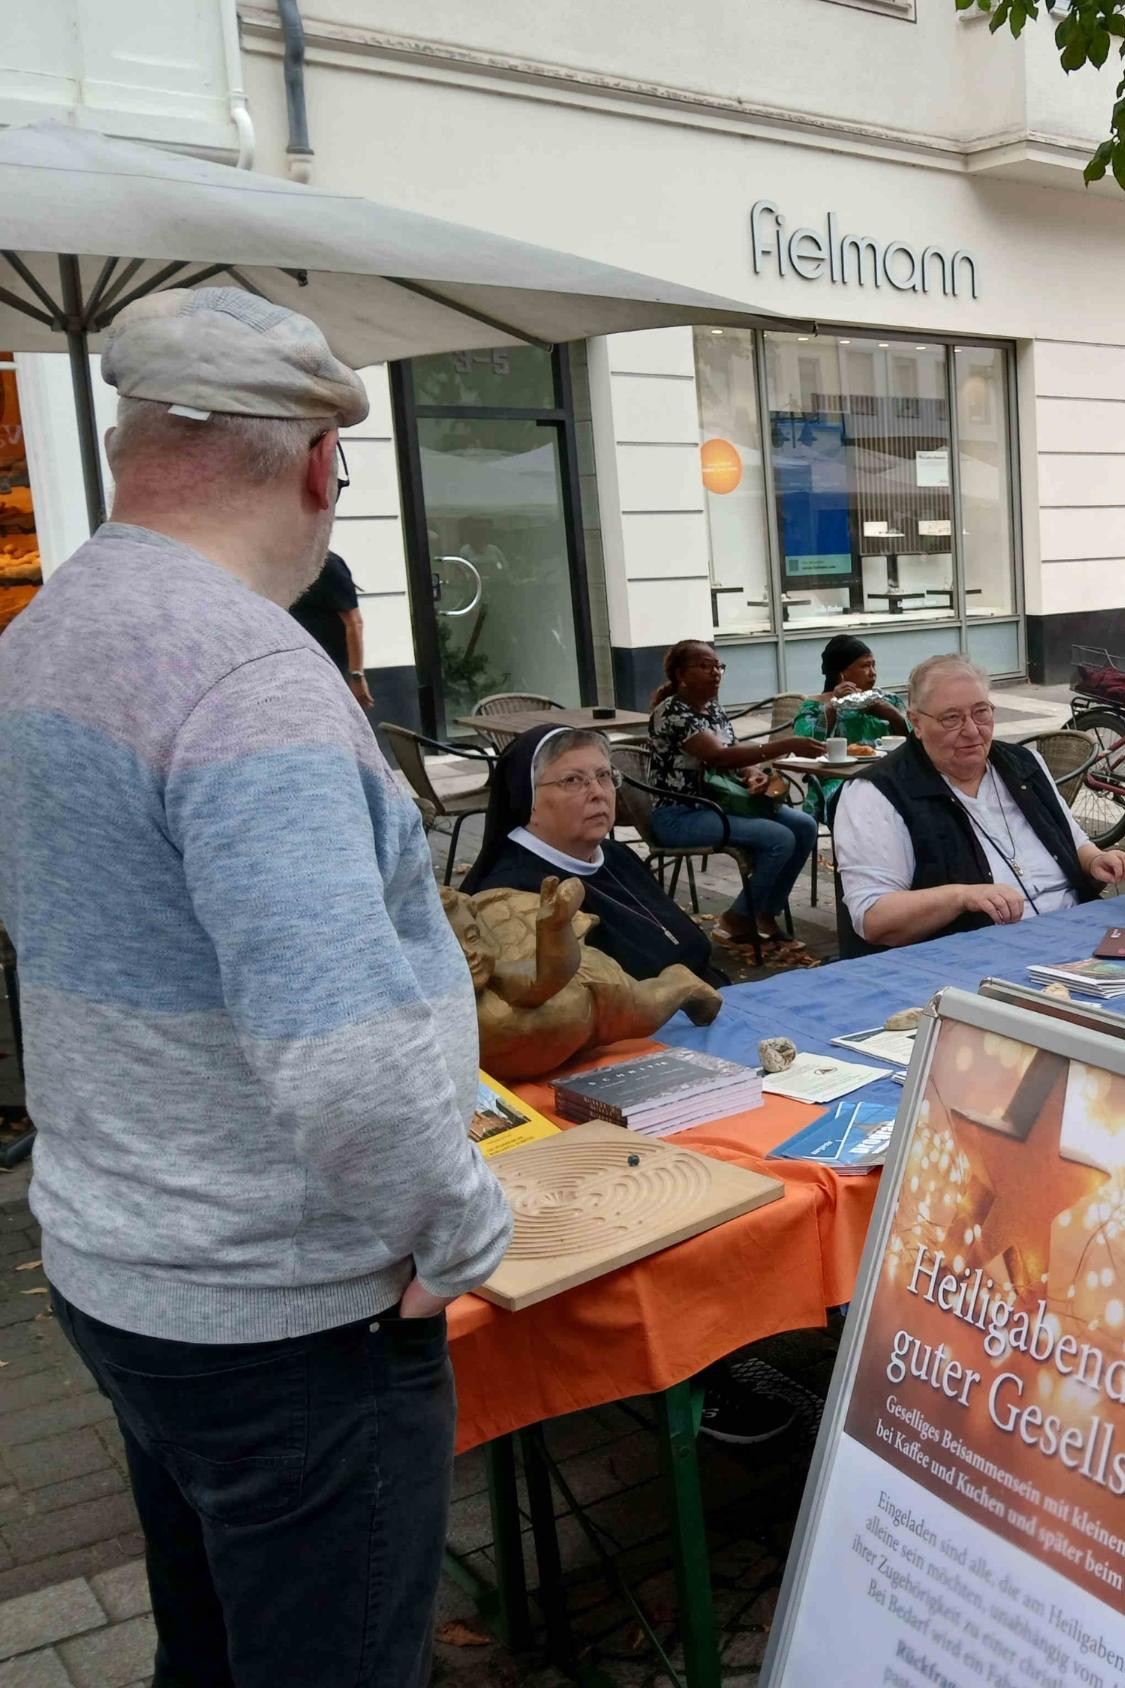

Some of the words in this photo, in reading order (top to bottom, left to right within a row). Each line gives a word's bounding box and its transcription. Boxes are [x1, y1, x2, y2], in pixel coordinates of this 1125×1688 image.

[886, 1329, 981, 1407] guter
[886, 1395, 941, 1442] Geselliges
[941, 1429, 1041, 1506] Beisammensein
[1043, 1495, 1070, 1522] mit
[876, 1418, 893, 1444] bei
[894, 1431, 930, 1468] Kaffee
[931, 1460, 956, 1485] und
[956, 1472, 1005, 1517] Kuchen
[1007, 1509, 1037, 1537] und
[1037, 1526, 1084, 1566] später
[1084, 1550, 1123, 1591] beim
[878, 1490, 937, 1547] Eingeladen
[940, 1538, 968, 1566] sind
[852, 1534, 878, 1566] ihrer
[865, 1515, 900, 1551] alleine
[901, 1544, 925, 1571] sein
[867, 1578, 887, 1606] Bei
[888, 1592, 932, 1636] Bedarf
